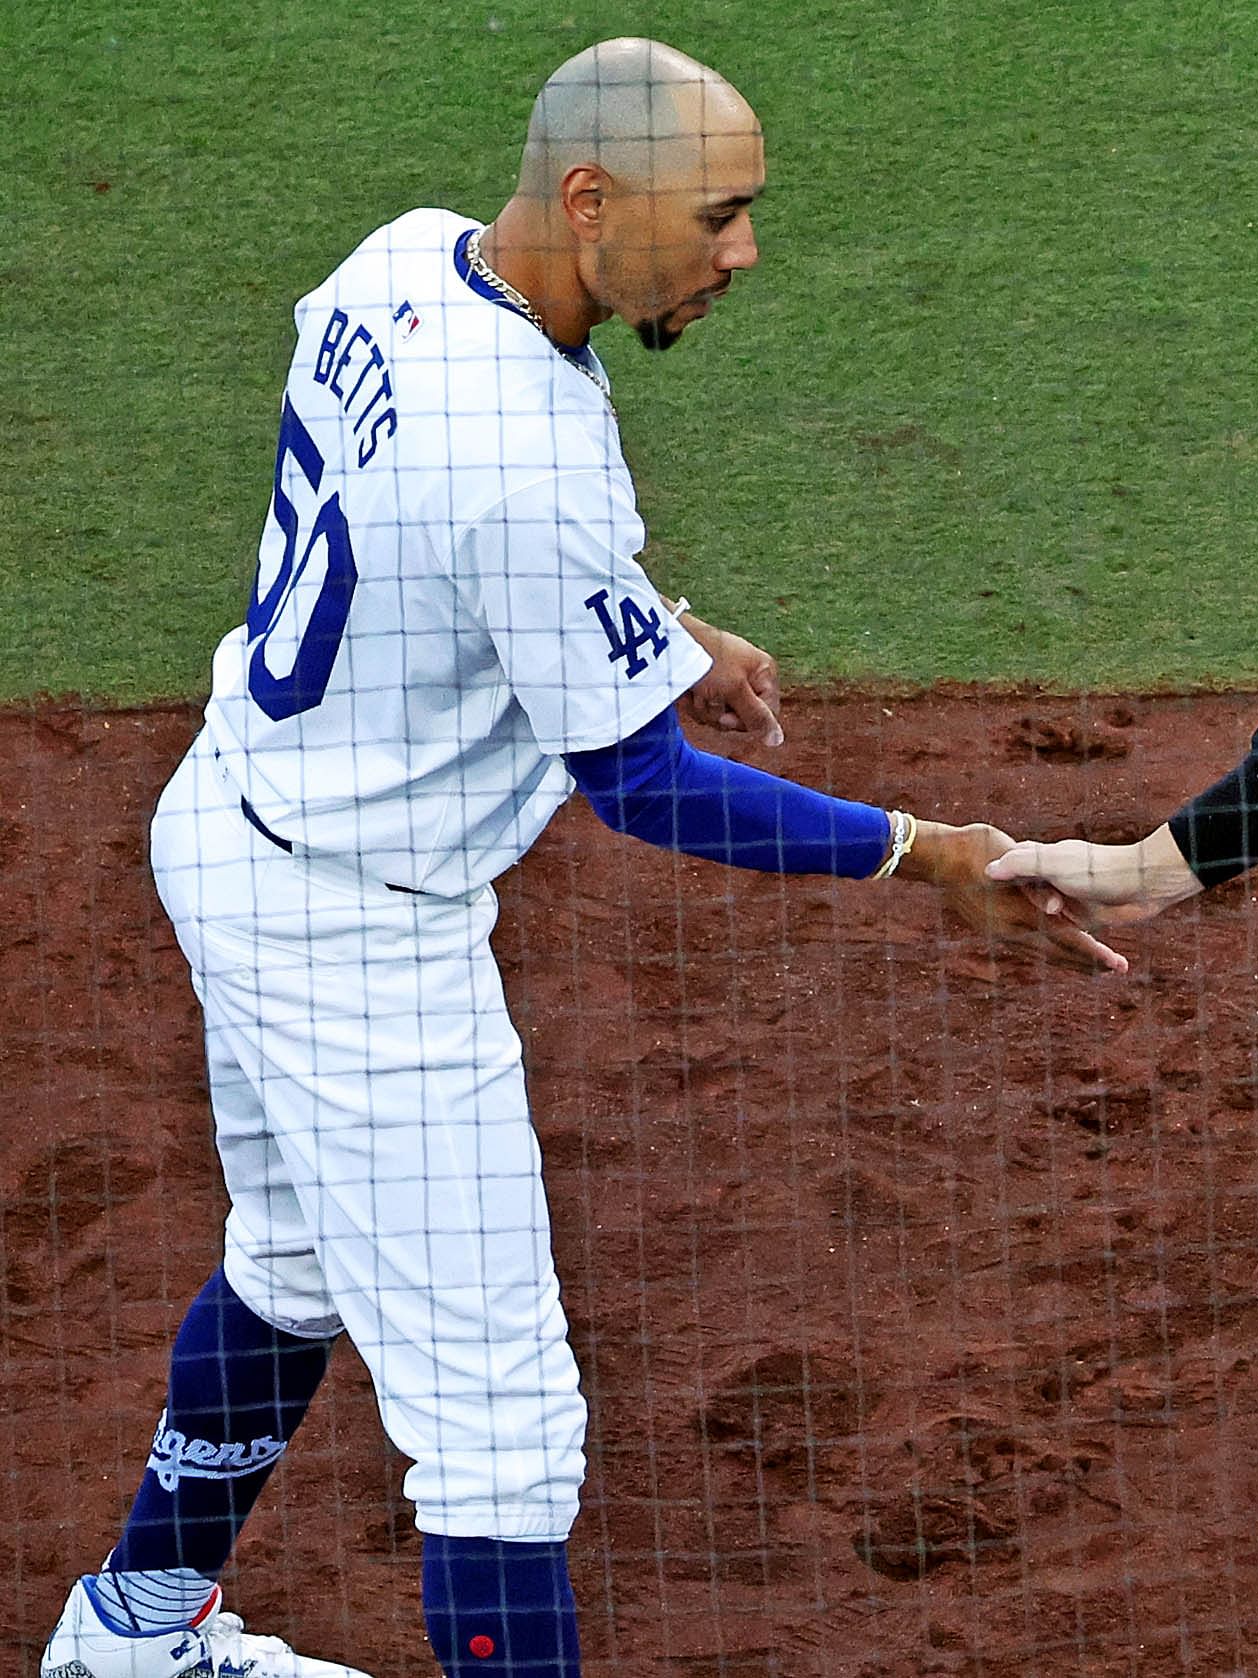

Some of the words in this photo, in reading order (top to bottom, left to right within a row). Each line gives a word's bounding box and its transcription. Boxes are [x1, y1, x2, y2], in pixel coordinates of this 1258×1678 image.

[314, 308, 397, 469] BETTS
[247, 391, 358, 722] 50
[585, 588, 669, 679] LA
